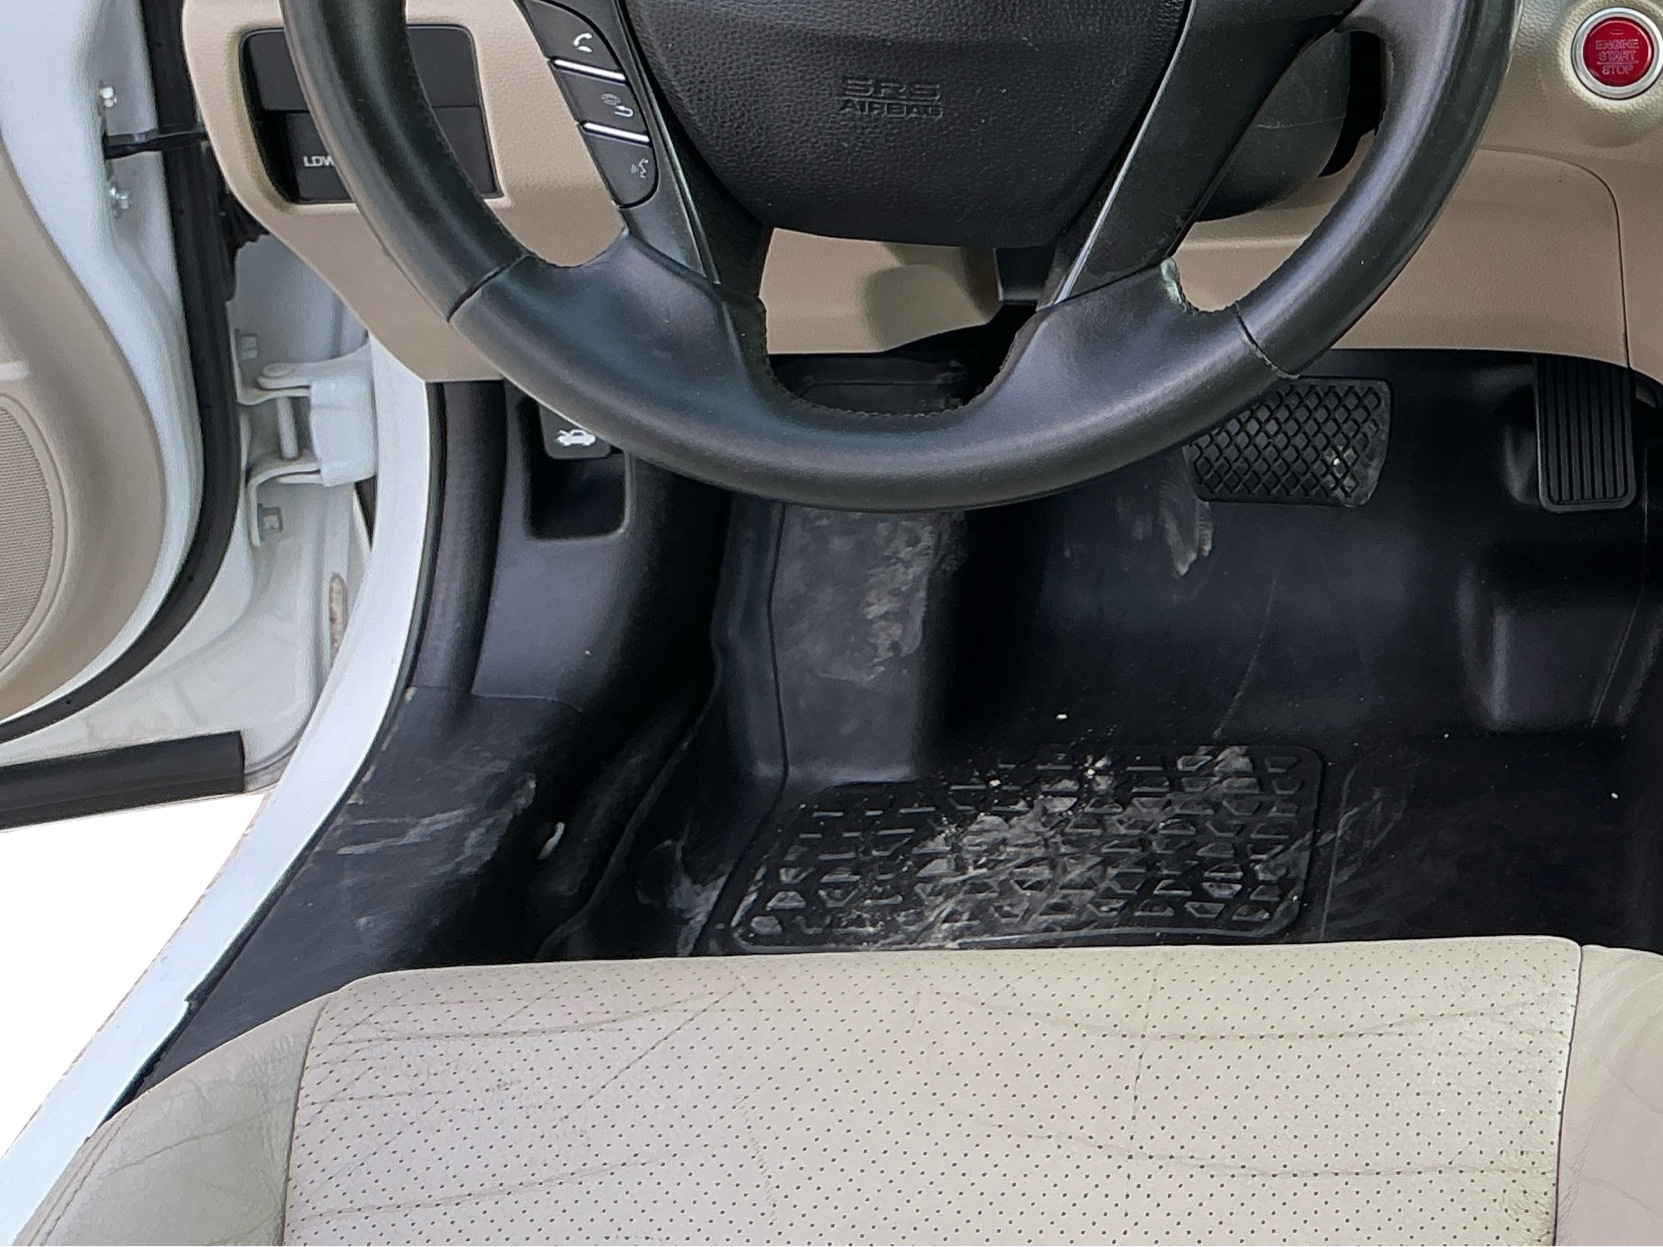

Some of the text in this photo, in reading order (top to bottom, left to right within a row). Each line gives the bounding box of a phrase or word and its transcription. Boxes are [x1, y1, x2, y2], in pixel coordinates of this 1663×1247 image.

[1595, 39, 1639, 50] ENGINE
[1598, 50, 1637, 62] START
[1601, 64, 1633, 75] STOP
